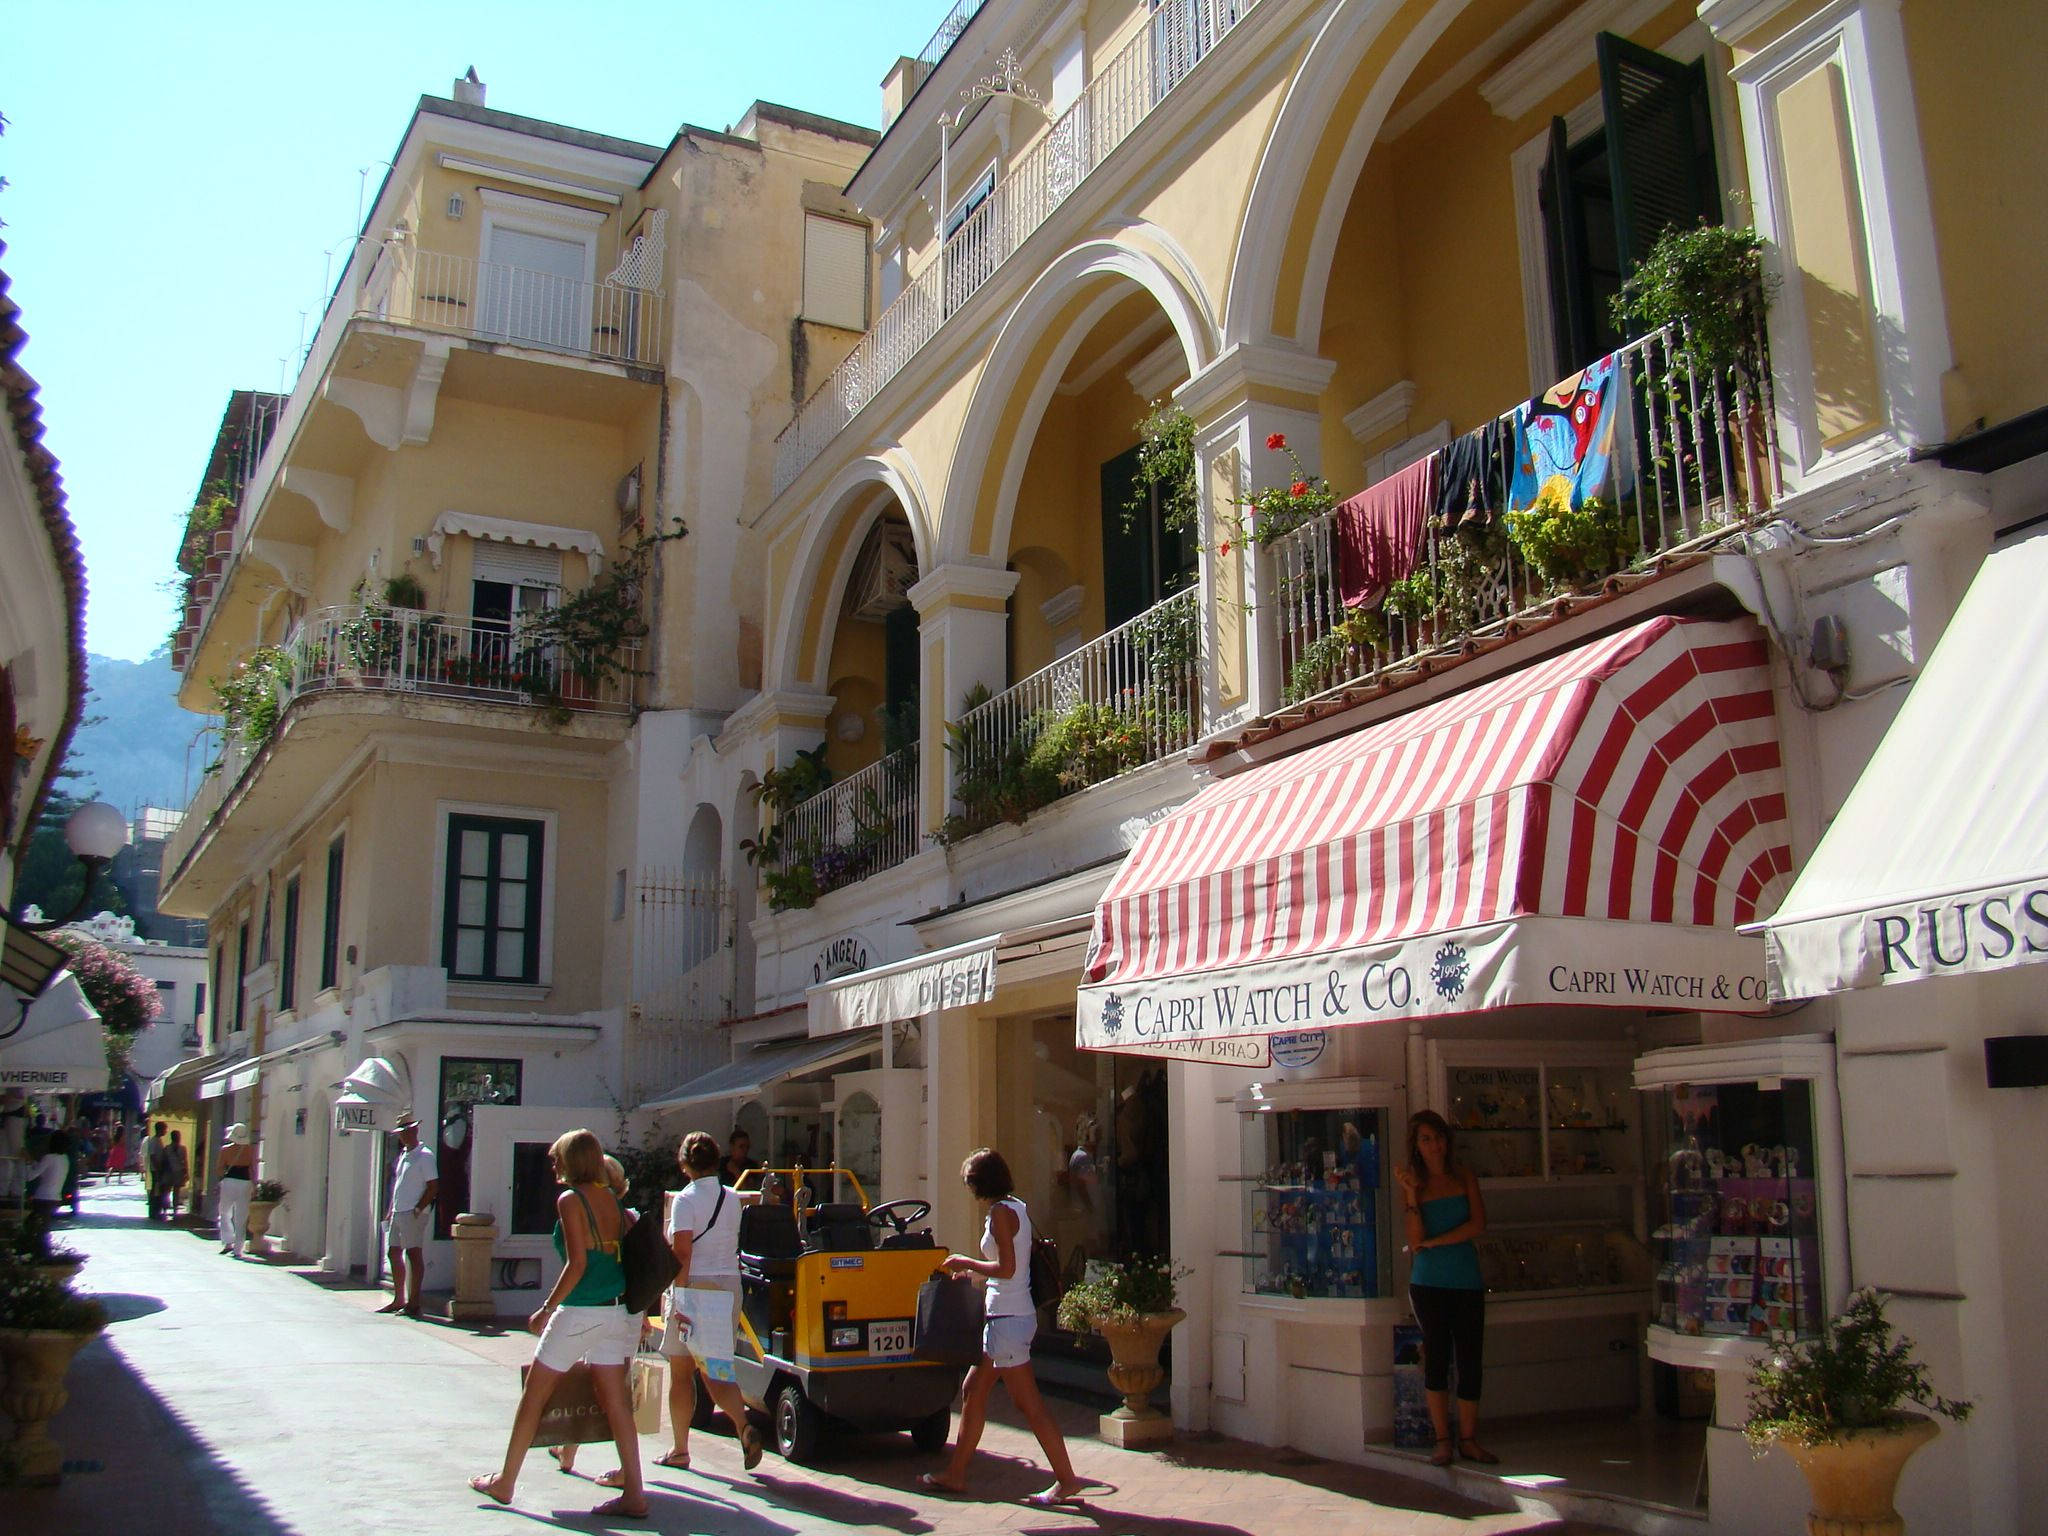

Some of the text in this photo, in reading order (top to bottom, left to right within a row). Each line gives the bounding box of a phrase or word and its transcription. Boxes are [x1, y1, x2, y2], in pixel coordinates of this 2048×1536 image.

[919, 966, 993, 1007] DIESEL
[1440, 965, 1461, 978] 1995
[1549, 966, 1616, 993] CAPRI
[1624, 969, 1704, 998] WATCH
[1711, 975, 1729, 999] &
[1135, 962, 1421, 1036] CAPRI WATCH & CO.
[874, 1335, 904, 1351] 120
